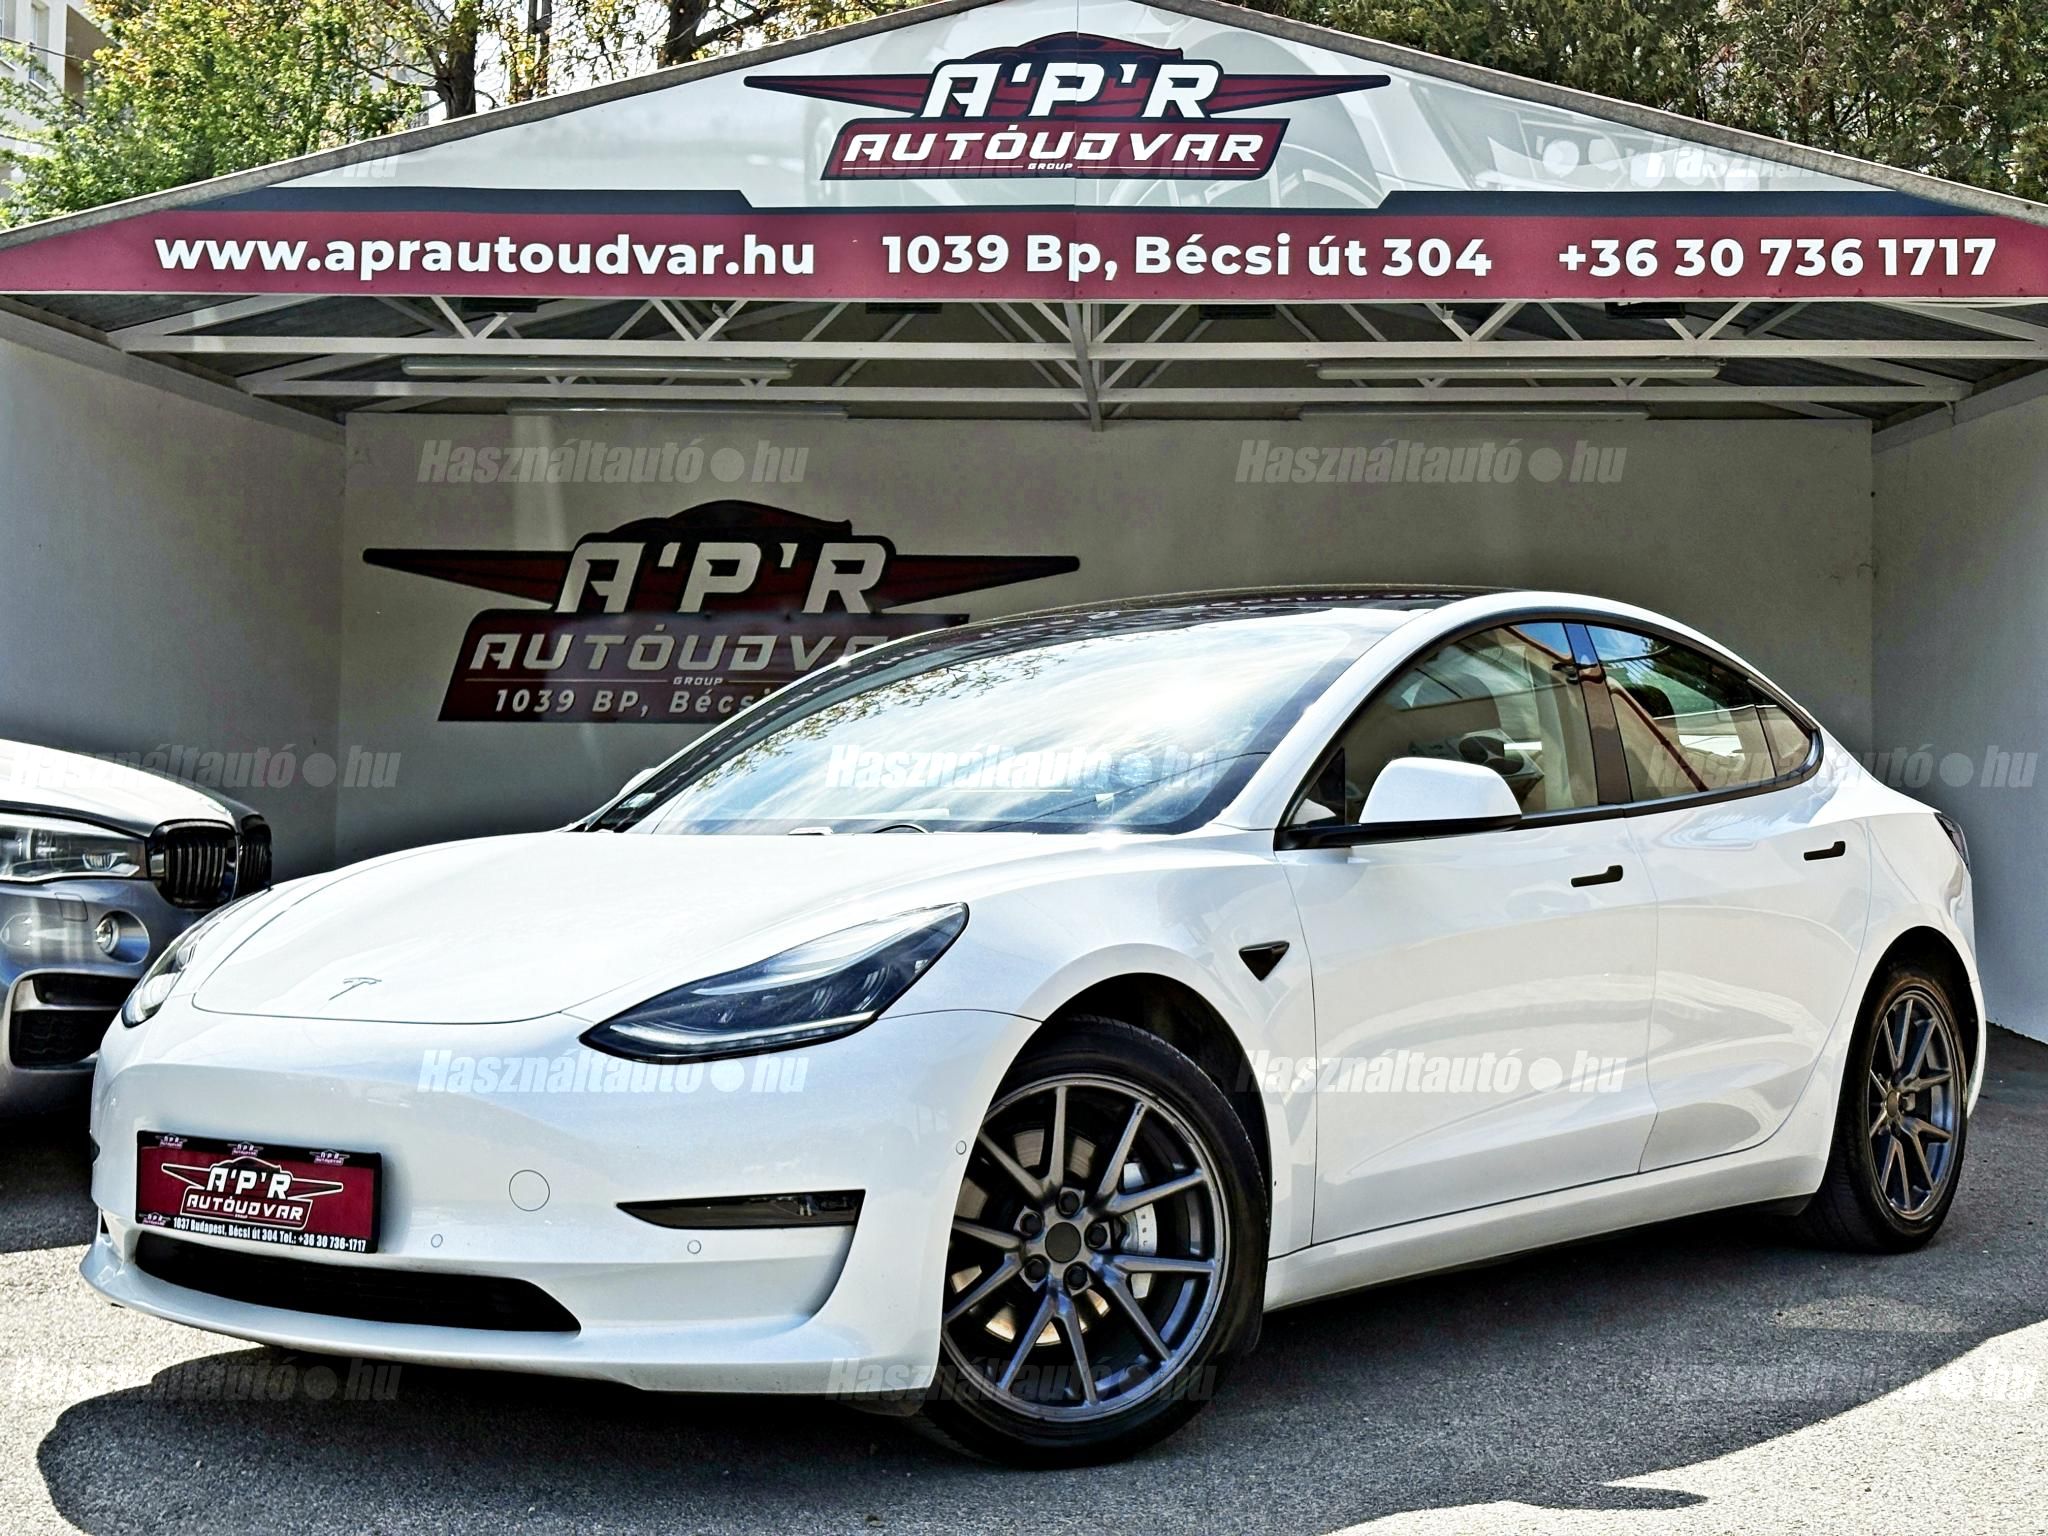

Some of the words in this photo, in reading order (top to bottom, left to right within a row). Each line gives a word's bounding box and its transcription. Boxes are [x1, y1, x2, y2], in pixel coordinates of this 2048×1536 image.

[842, 124, 1264, 162] AUTÓUDVAR
[1027, 162, 1073, 170] GROUP
[154, 233, 815, 281] www.aprautoudvar.hu
[883, 234, 1009, 275] 1039
[1026, 235, 1118, 283] Bp,
[1136, 233, 1290, 276] Bécsi
[1308, 233, 1367, 277] út
[1382, 237, 1493, 278] 304
[1558, 238, 1659, 278] +36
[1675, 238, 1745, 278] 30
[1760, 238, 1864, 278] 736
[1877, 237, 1998, 277] 1717
[468, 624, 890, 672] AUTÓUDV
[672, 676, 724, 686] GROUP
[494, 689, 575, 714] 1039
[591, 689, 648, 718] BP,
[668, 687, 770, 715] Bécs
[186, 1194, 304, 1221] AUTÓUDVAR
[261, 1229, 278, 1242] 304
